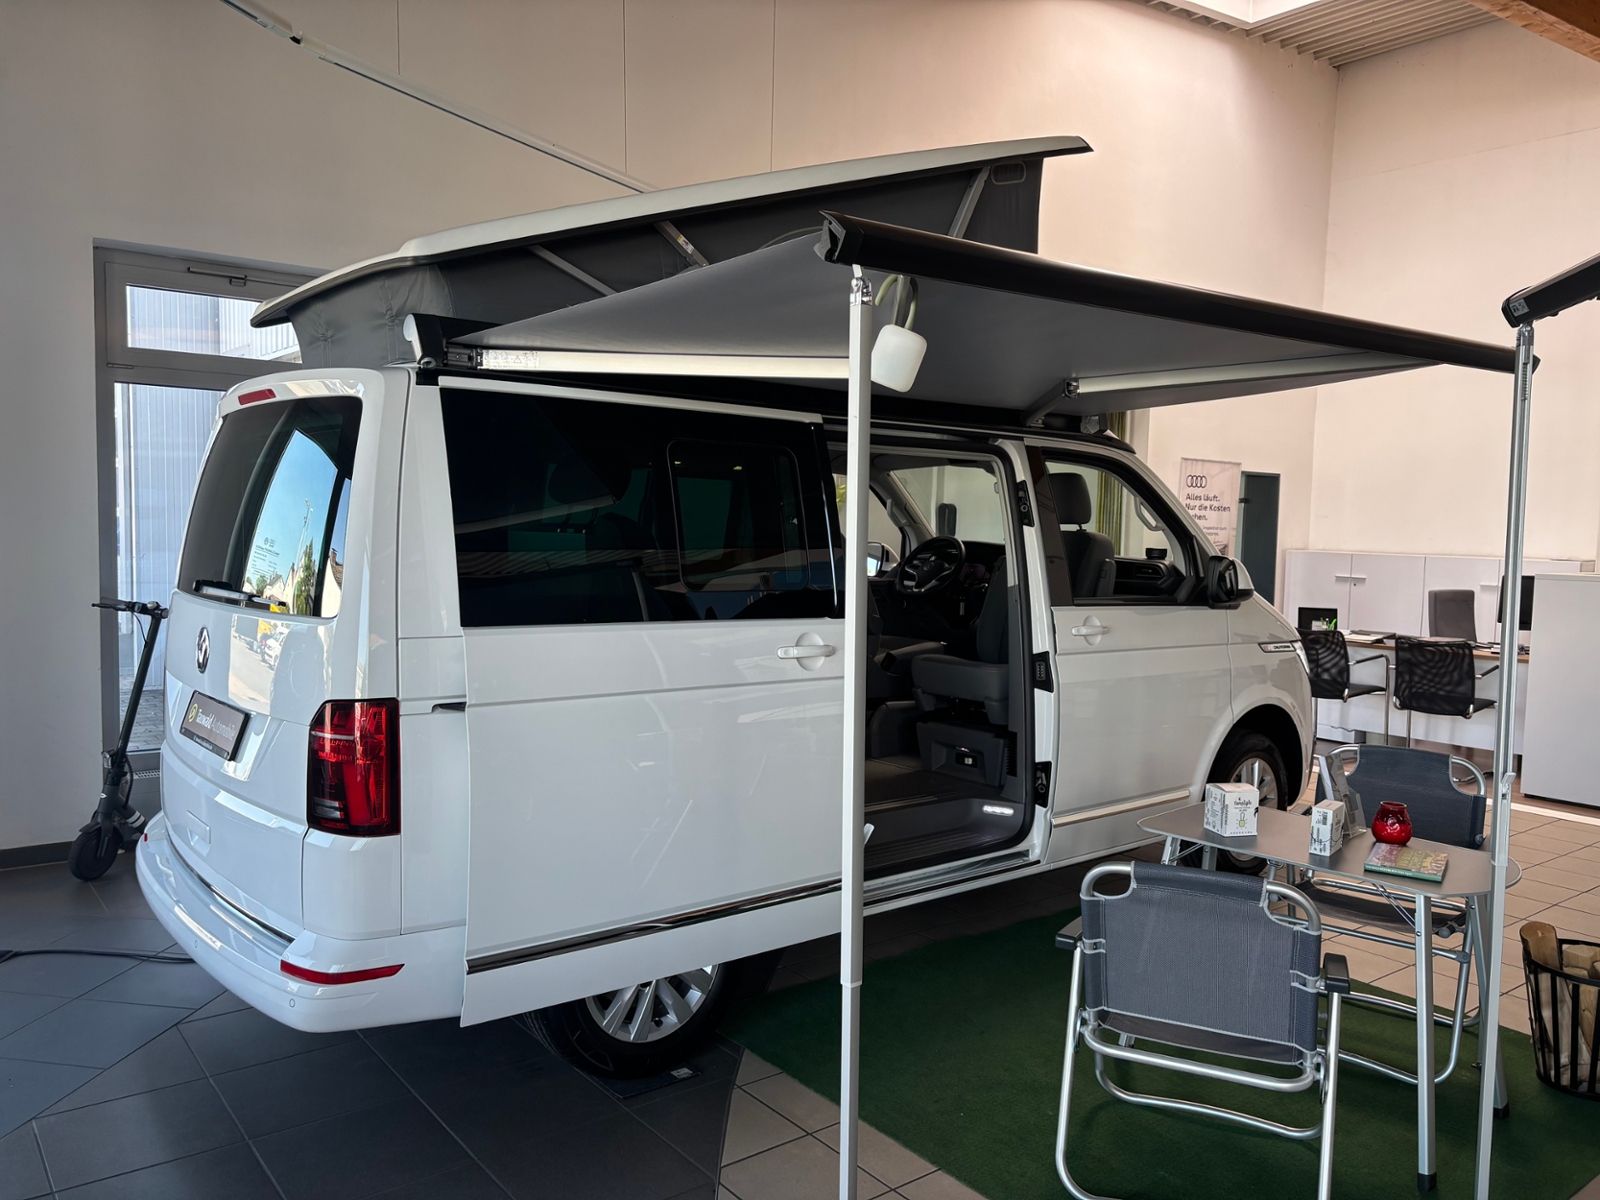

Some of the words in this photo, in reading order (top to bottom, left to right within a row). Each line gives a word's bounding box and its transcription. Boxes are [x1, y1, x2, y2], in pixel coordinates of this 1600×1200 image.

[1185, 493, 1202, 501] Alles
[1203, 494, 1221, 502] läuft.
[1185, 502, 1197, 511] Nur
[1198, 503, 1208, 511] die
[1209, 504, 1231, 512] Kosten
